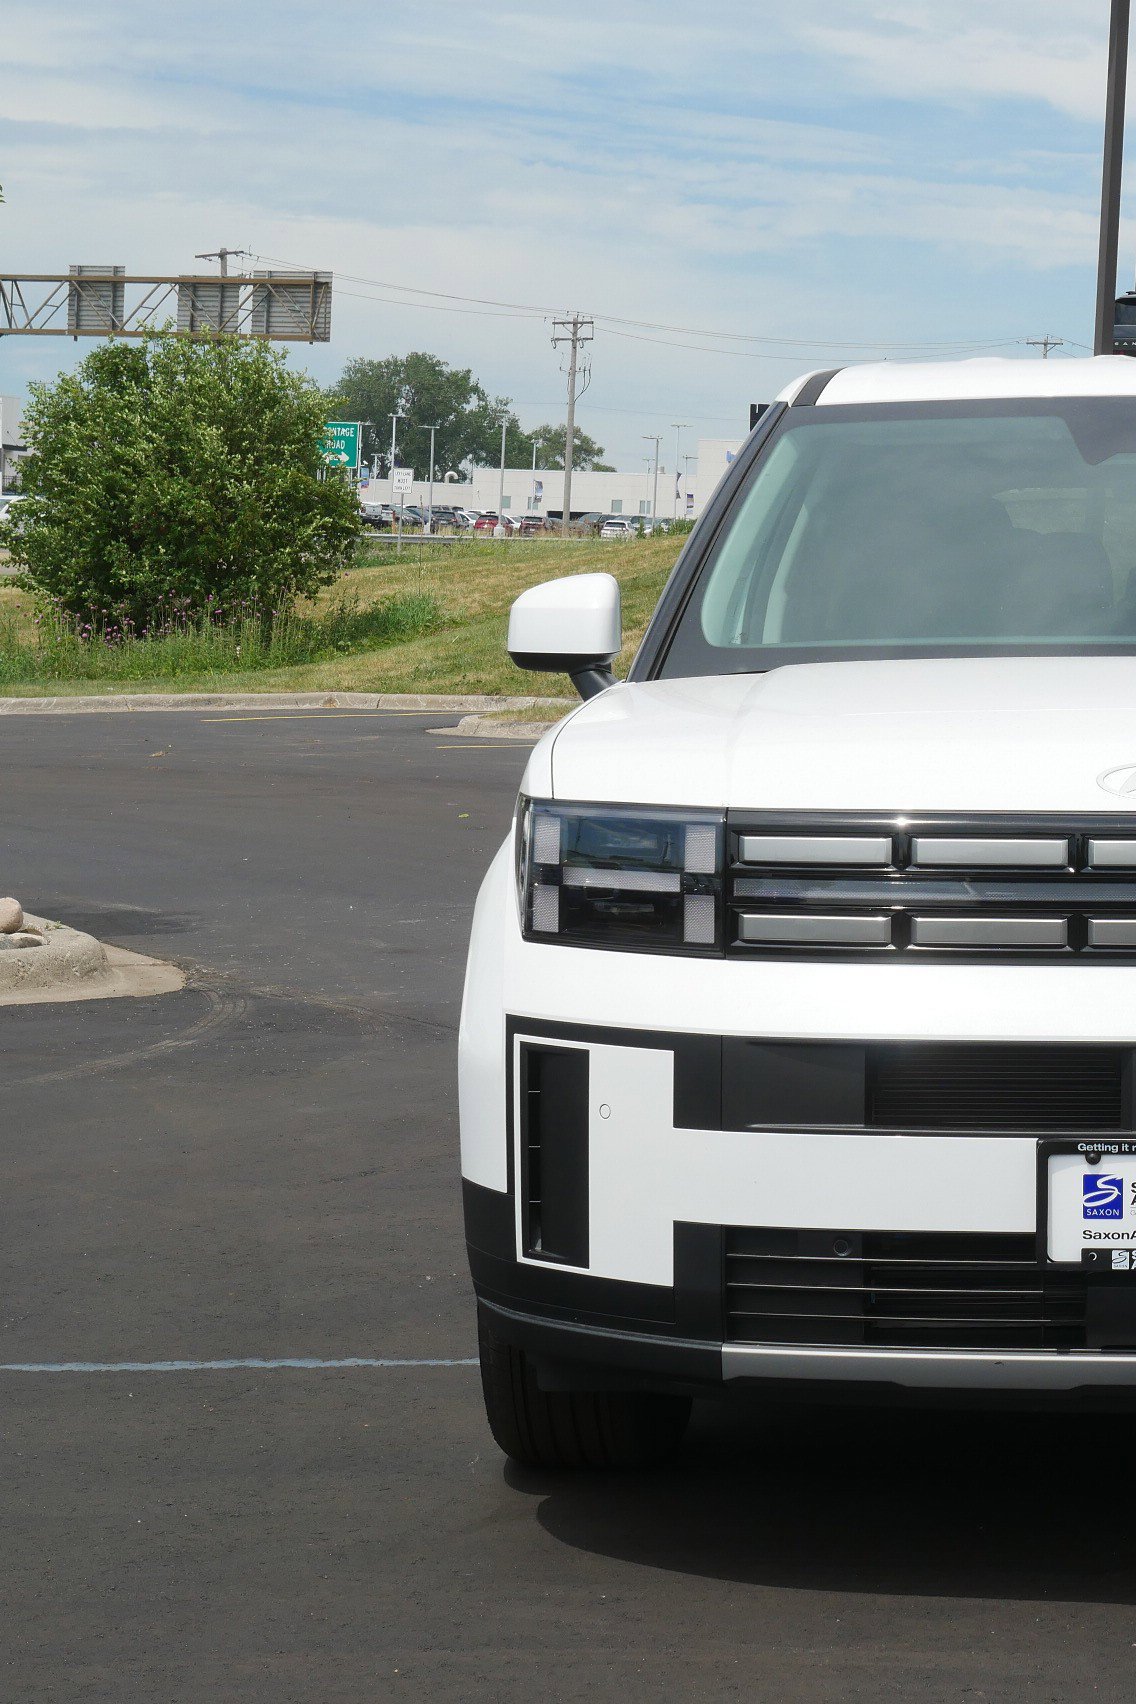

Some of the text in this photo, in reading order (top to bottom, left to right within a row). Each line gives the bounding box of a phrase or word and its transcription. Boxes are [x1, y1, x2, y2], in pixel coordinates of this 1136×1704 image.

[1077, 1143, 1119, 1153] Getting
[1121, 1143, 1129, 1152] it
[1086, 1208, 1120, 1216] SAXON
